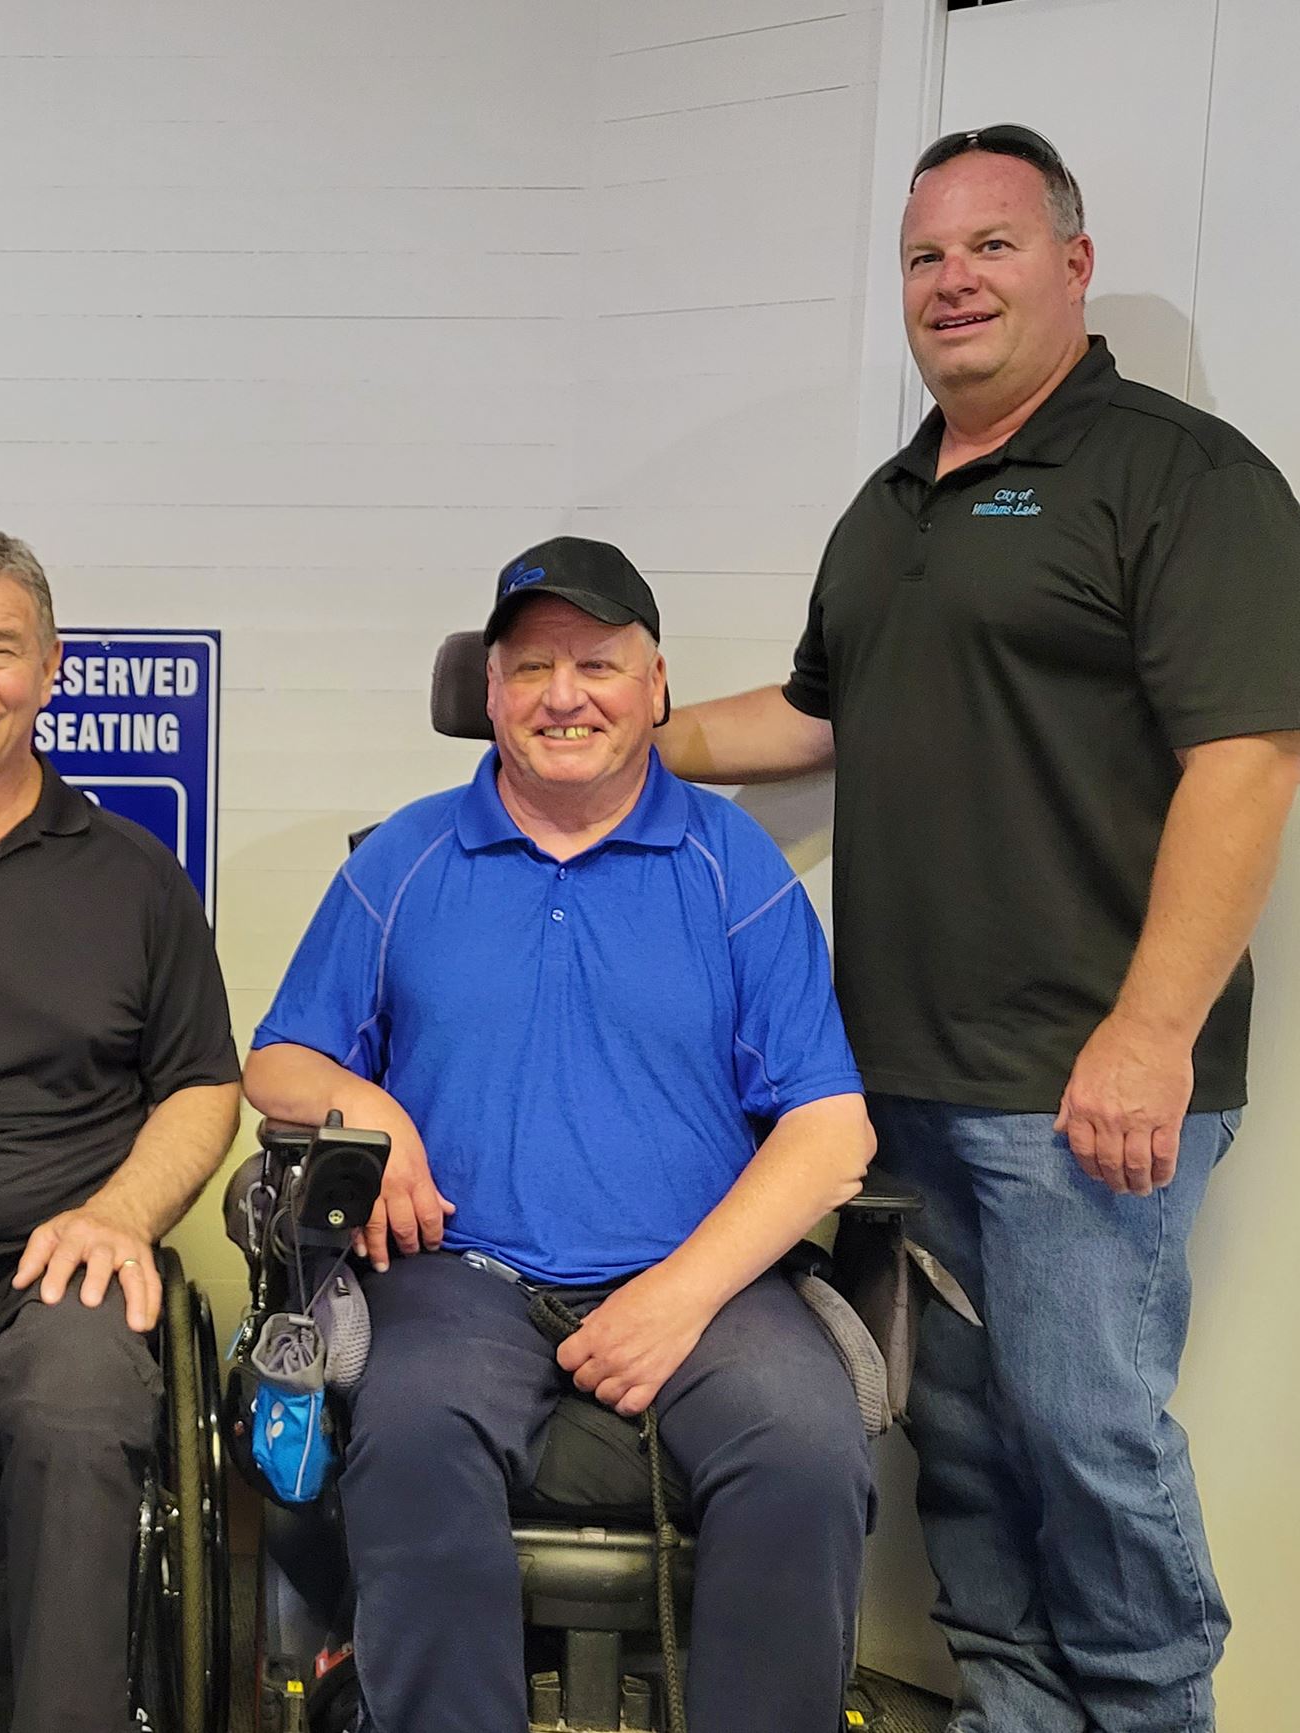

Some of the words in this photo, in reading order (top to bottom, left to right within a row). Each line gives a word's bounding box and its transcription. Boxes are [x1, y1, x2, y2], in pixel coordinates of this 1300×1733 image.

[994, 489, 1017, 502] City
[1018, 488, 1035, 501] of
[971, 502, 1013, 515] Williams
[1013, 502, 1042, 516] Lake
[34, 712, 180, 754] SEATING
